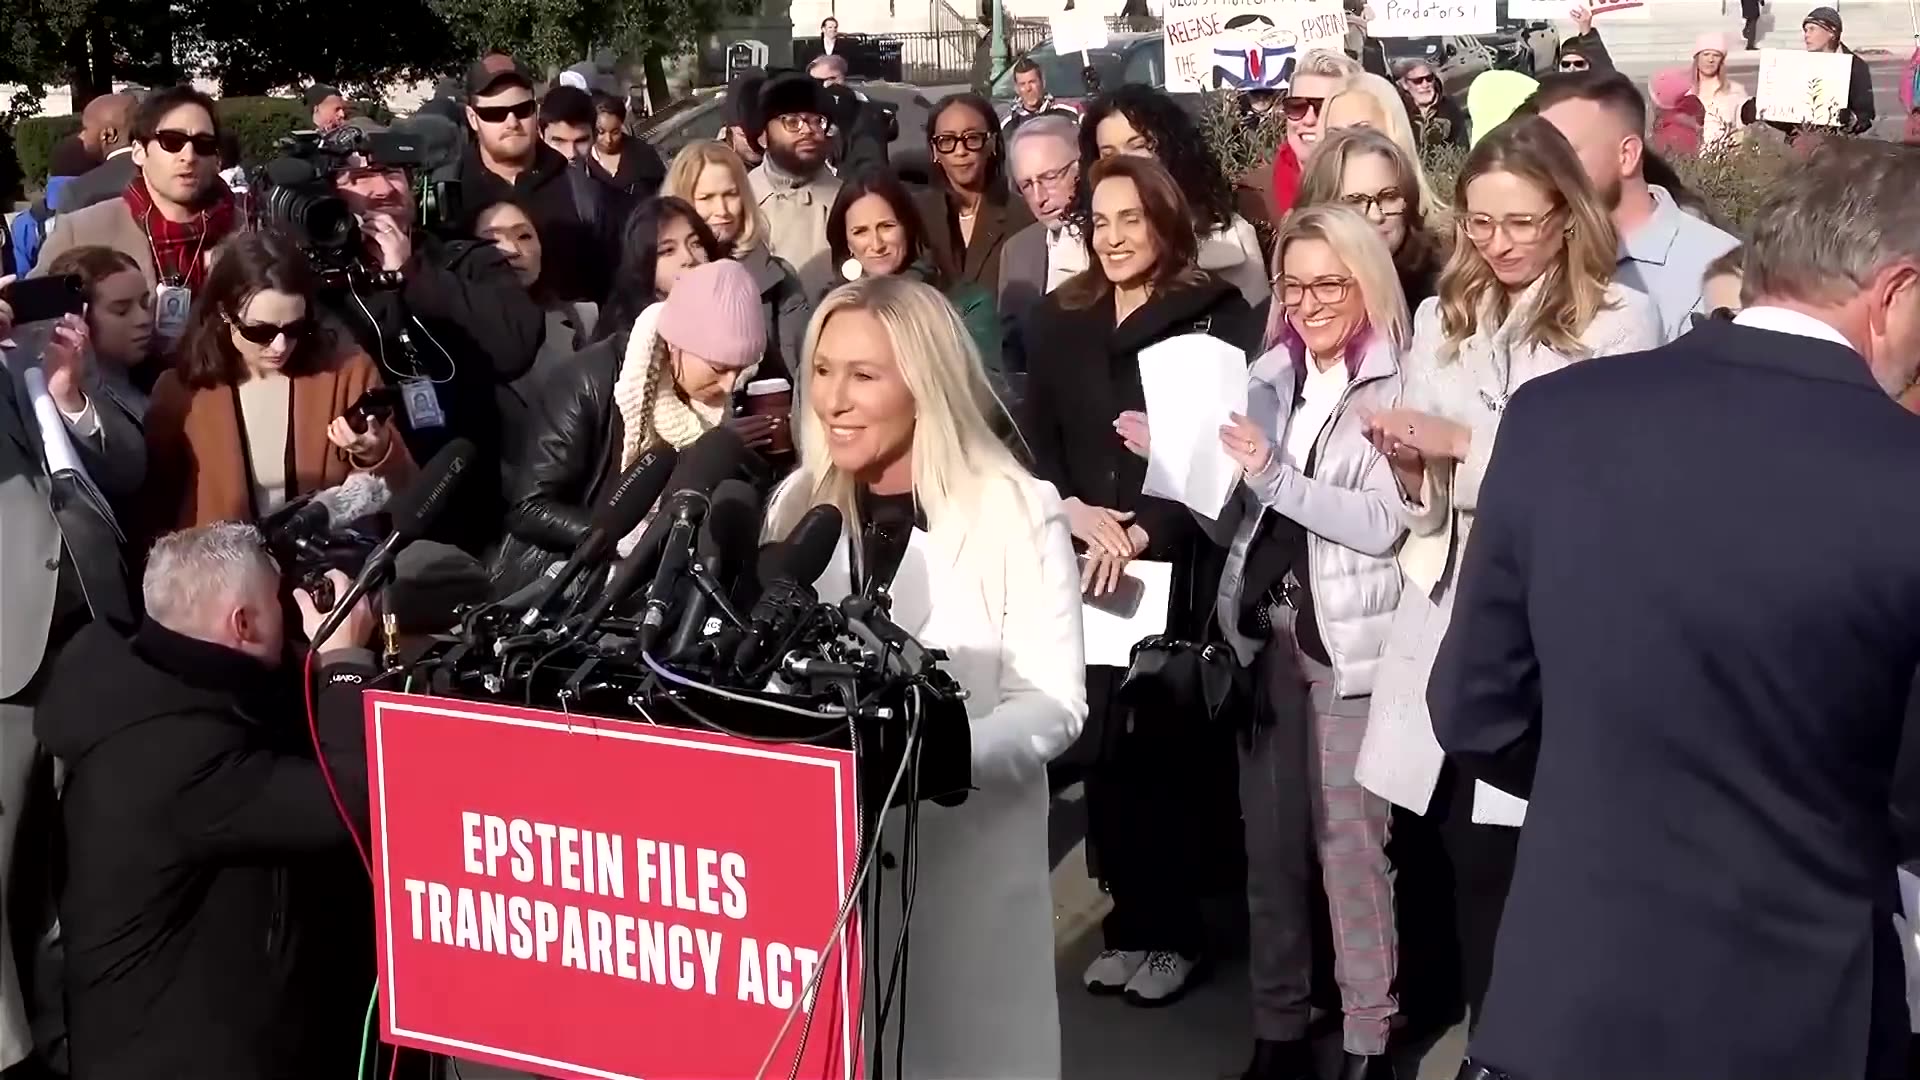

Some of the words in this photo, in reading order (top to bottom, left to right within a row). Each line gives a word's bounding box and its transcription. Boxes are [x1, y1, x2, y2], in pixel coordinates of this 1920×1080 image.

[1166, 12, 1223, 46] RELEASE
[1301, 12, 1346, 42] EPSTEIN
[1175, 53, 1197, 76] THE
[462, 811, 625, 899] EPSTEIN
[636, 837, 748, 920] FILES
[404, 878, 723, 995] TRANSPARENCY
[737, 937, 819, 1014] ACT
